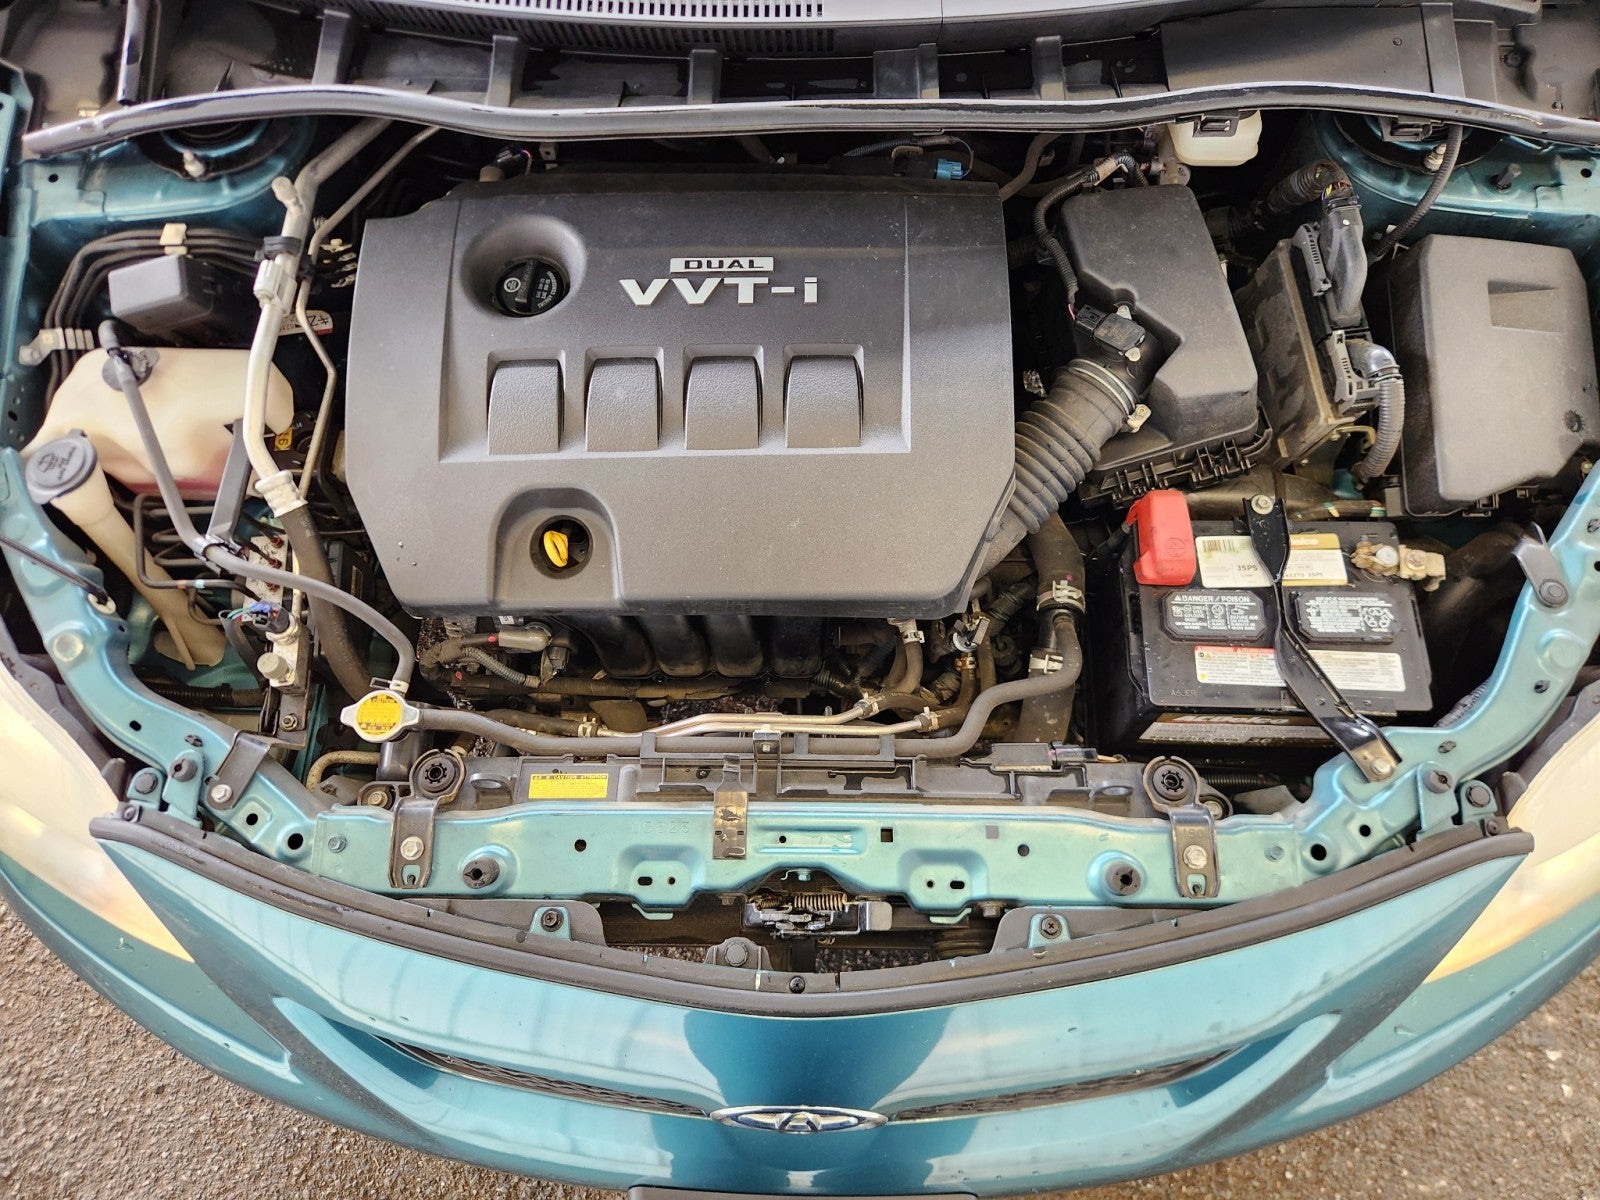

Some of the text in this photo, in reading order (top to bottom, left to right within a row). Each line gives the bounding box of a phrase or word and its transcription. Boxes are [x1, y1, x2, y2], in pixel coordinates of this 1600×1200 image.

[684, 259, 764, 270] DUAL
[619, 277, 818, 306] VVT-i
[1221, 595, 1250, 603] POISON
